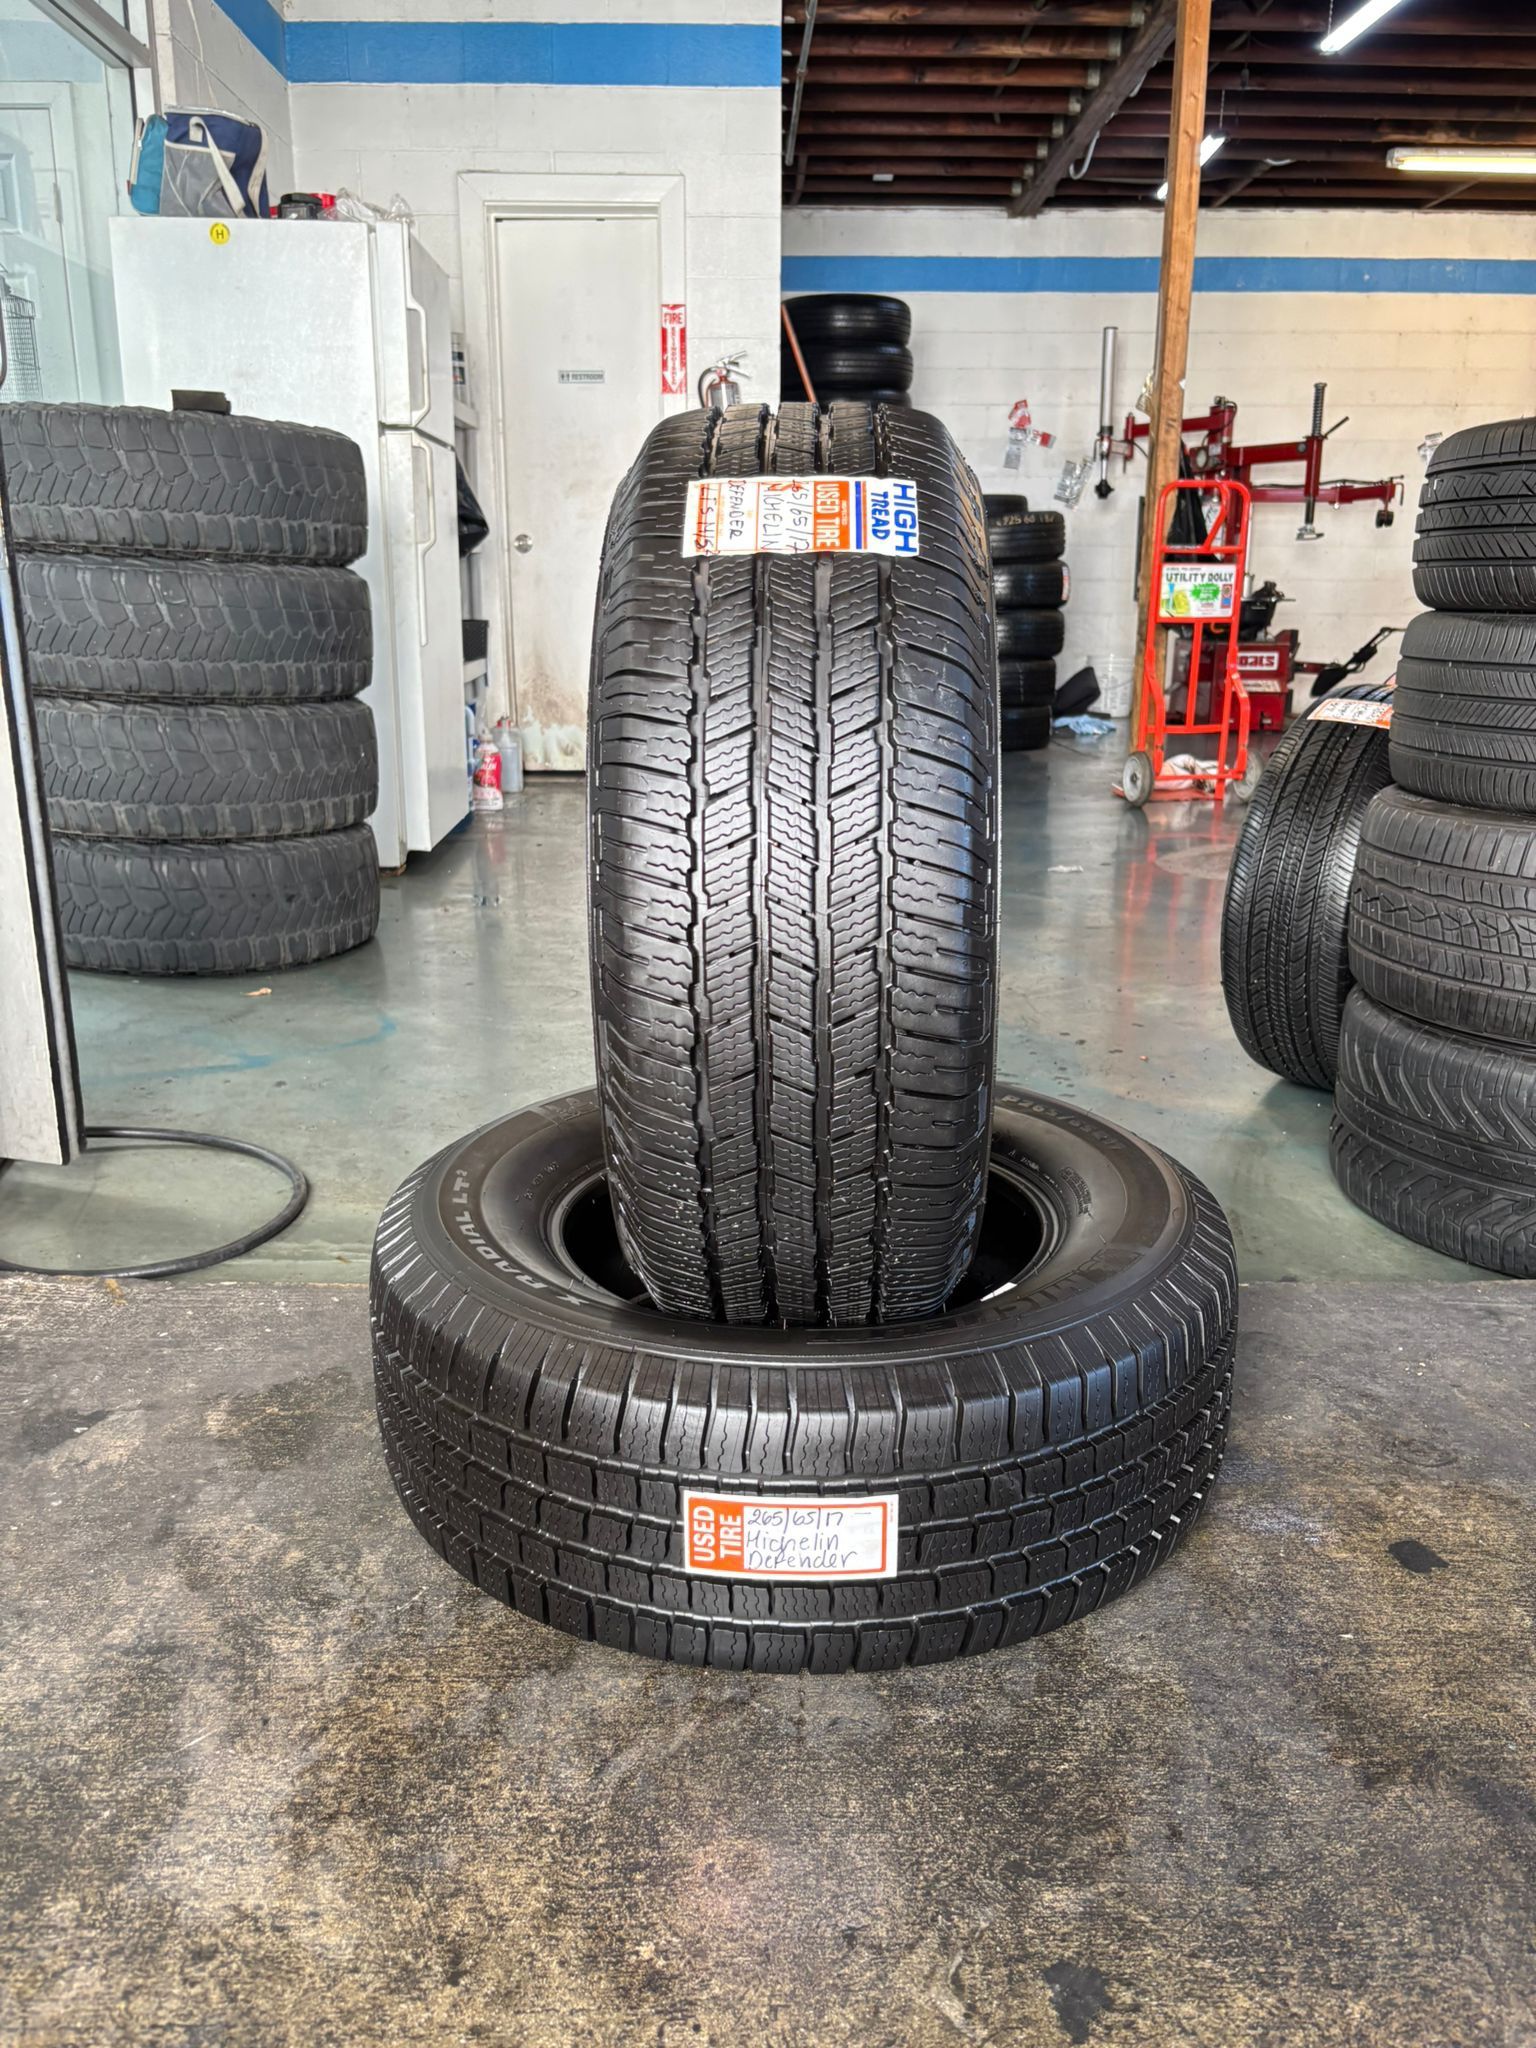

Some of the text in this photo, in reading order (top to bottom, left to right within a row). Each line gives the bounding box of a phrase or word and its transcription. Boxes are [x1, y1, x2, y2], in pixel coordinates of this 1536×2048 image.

[215, 229, 225, 239] H
[664, 313, 683, 324] FIRE
[728, 479, 747, 540] DEFENDER
[761, 481, 784, 550] MICHELIN
[816, 483, 840, 547] USED TIRE
[871, 491, 890, 540] TREAD
[893, 483, 917, 552] HIGH
[1166, 573, 1233, 582] UTILITY DOLLY
[455, 1210, 549, 1289] RADIAL
[693, 1505, 716, 1562] USED
[719, 1515, 742, 1559] TIRE
[747, 1507, 844, 1533] 265/65/17
